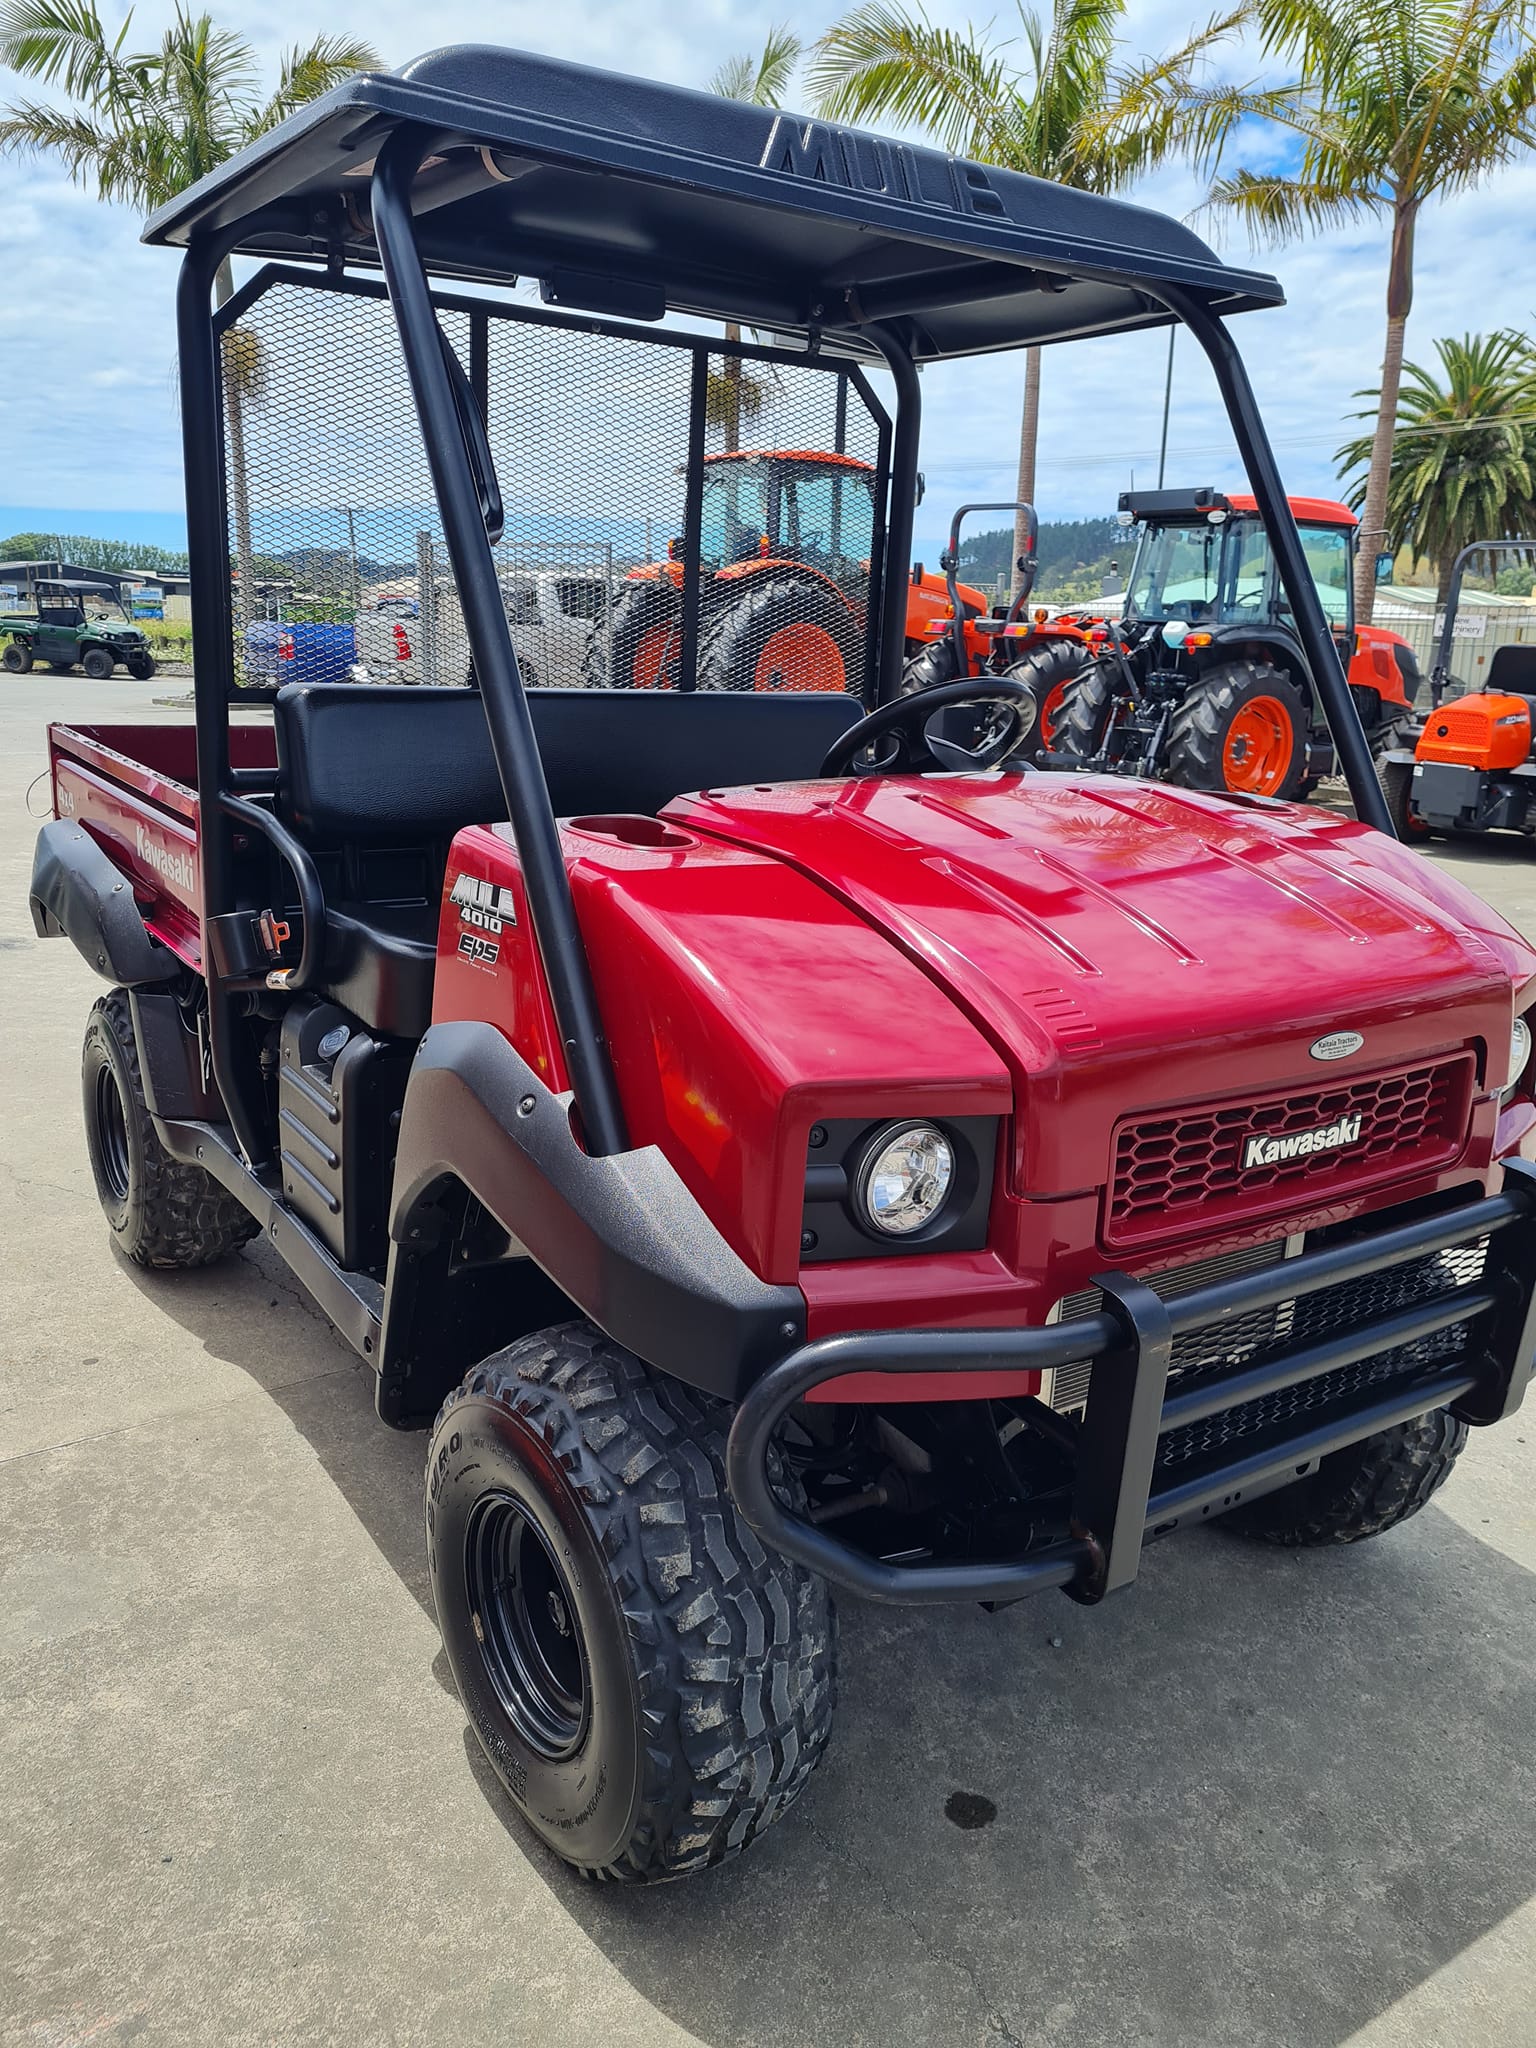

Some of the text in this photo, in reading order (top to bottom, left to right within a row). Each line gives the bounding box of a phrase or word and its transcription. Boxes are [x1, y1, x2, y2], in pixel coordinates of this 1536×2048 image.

[759, 115, 1015, 224] MULE
[58, 785, 75, 813] 4x4
[136, 823, 194, 893] Kawasaki
[449, 873, 517, 926] MULE
[460, 906, 503, 934] 4010
[1337, 1035, 1358, 1046] Tractors
[1245, 1114, 1362, 1169] Kawasaki
